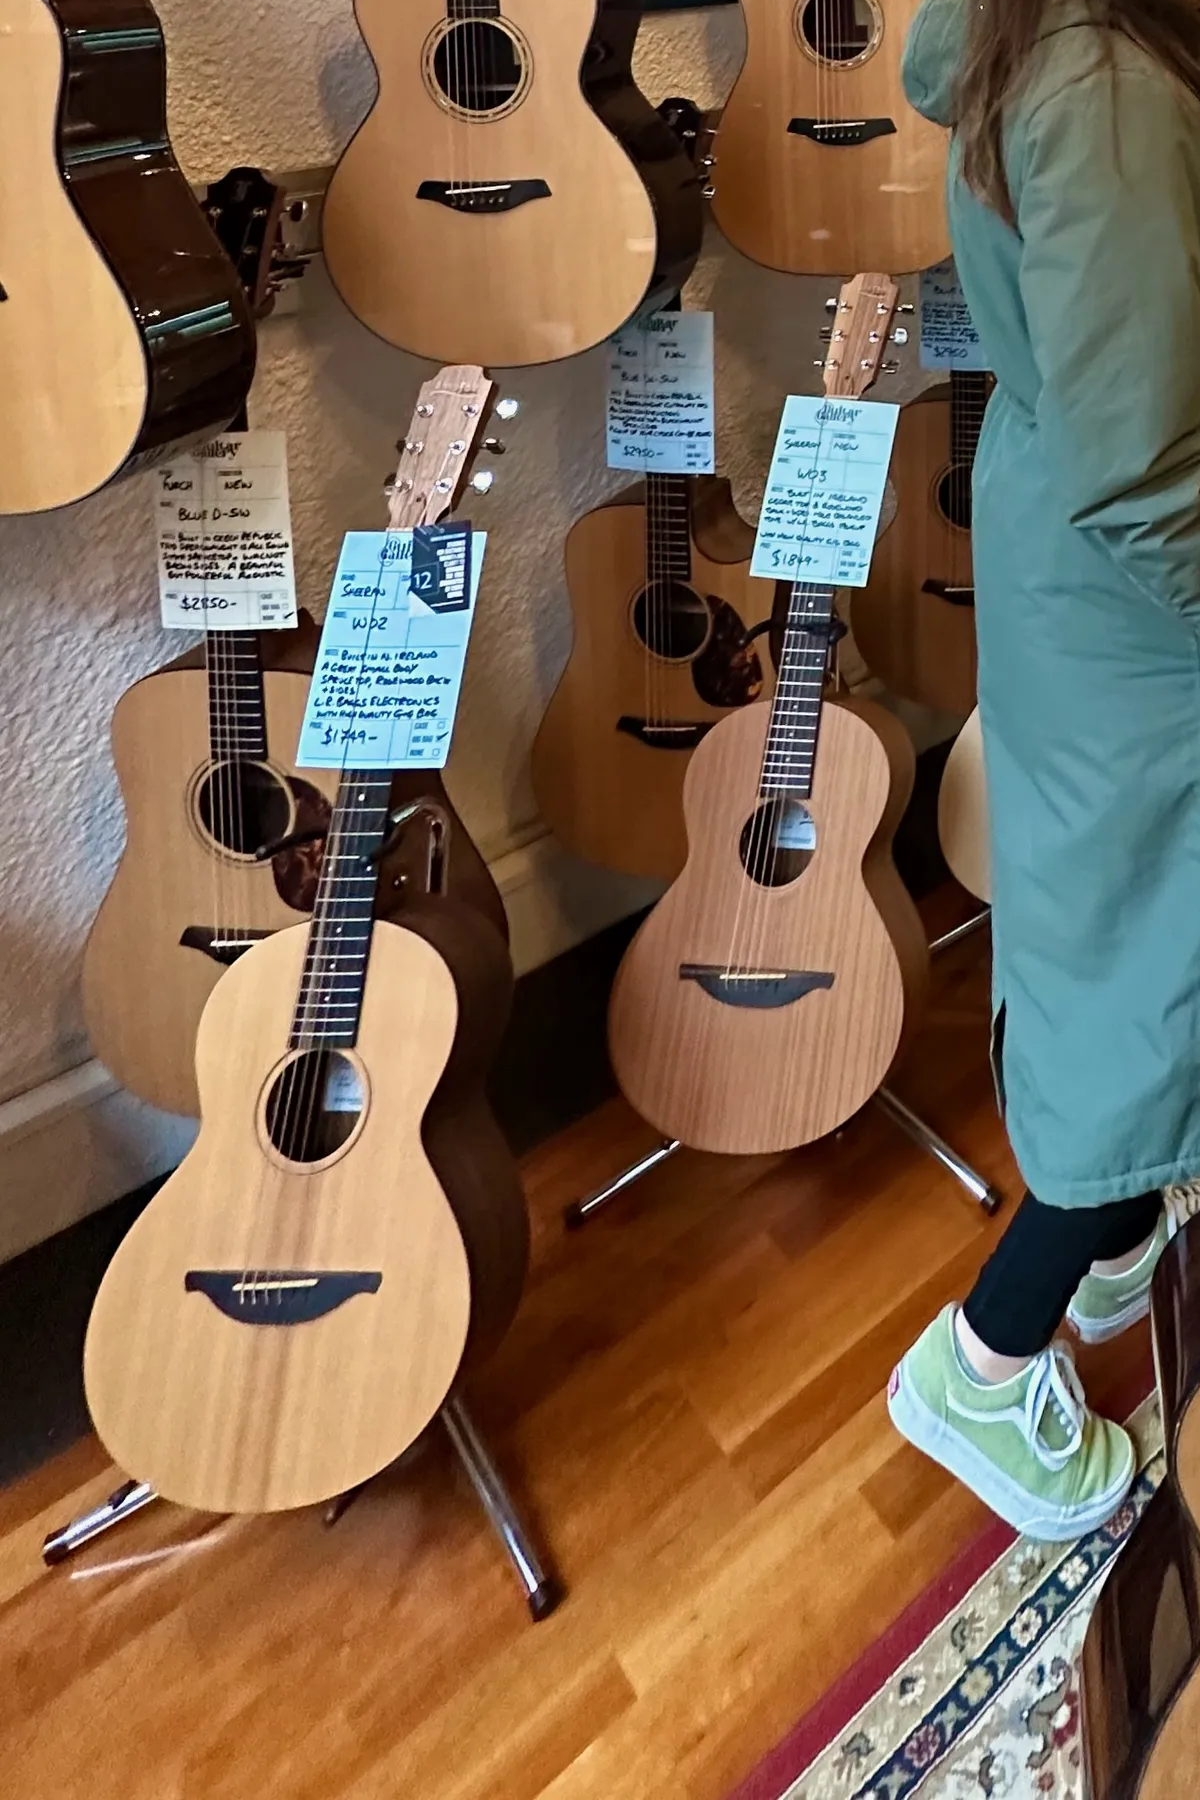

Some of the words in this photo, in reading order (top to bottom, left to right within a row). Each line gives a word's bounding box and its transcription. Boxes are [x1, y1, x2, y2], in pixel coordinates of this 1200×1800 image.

[833, 442, 859, 450] NEW
[224, 480, 252, 490] NEW
[179, 508, 207, 521] BLUE
[413, 572, 433, 589] 12
[341, 585, 386, 598] SHEERAN
[392, 651, 438, 660] IRELAND
[321, 664, 329, 672] A
[360, 665, 390, 674] SMALL
[393, 664, 419, 674] BODY
[370, 696, 440, 707] ELECTRONICS
[360, 710, 392, 719] QUALITY
